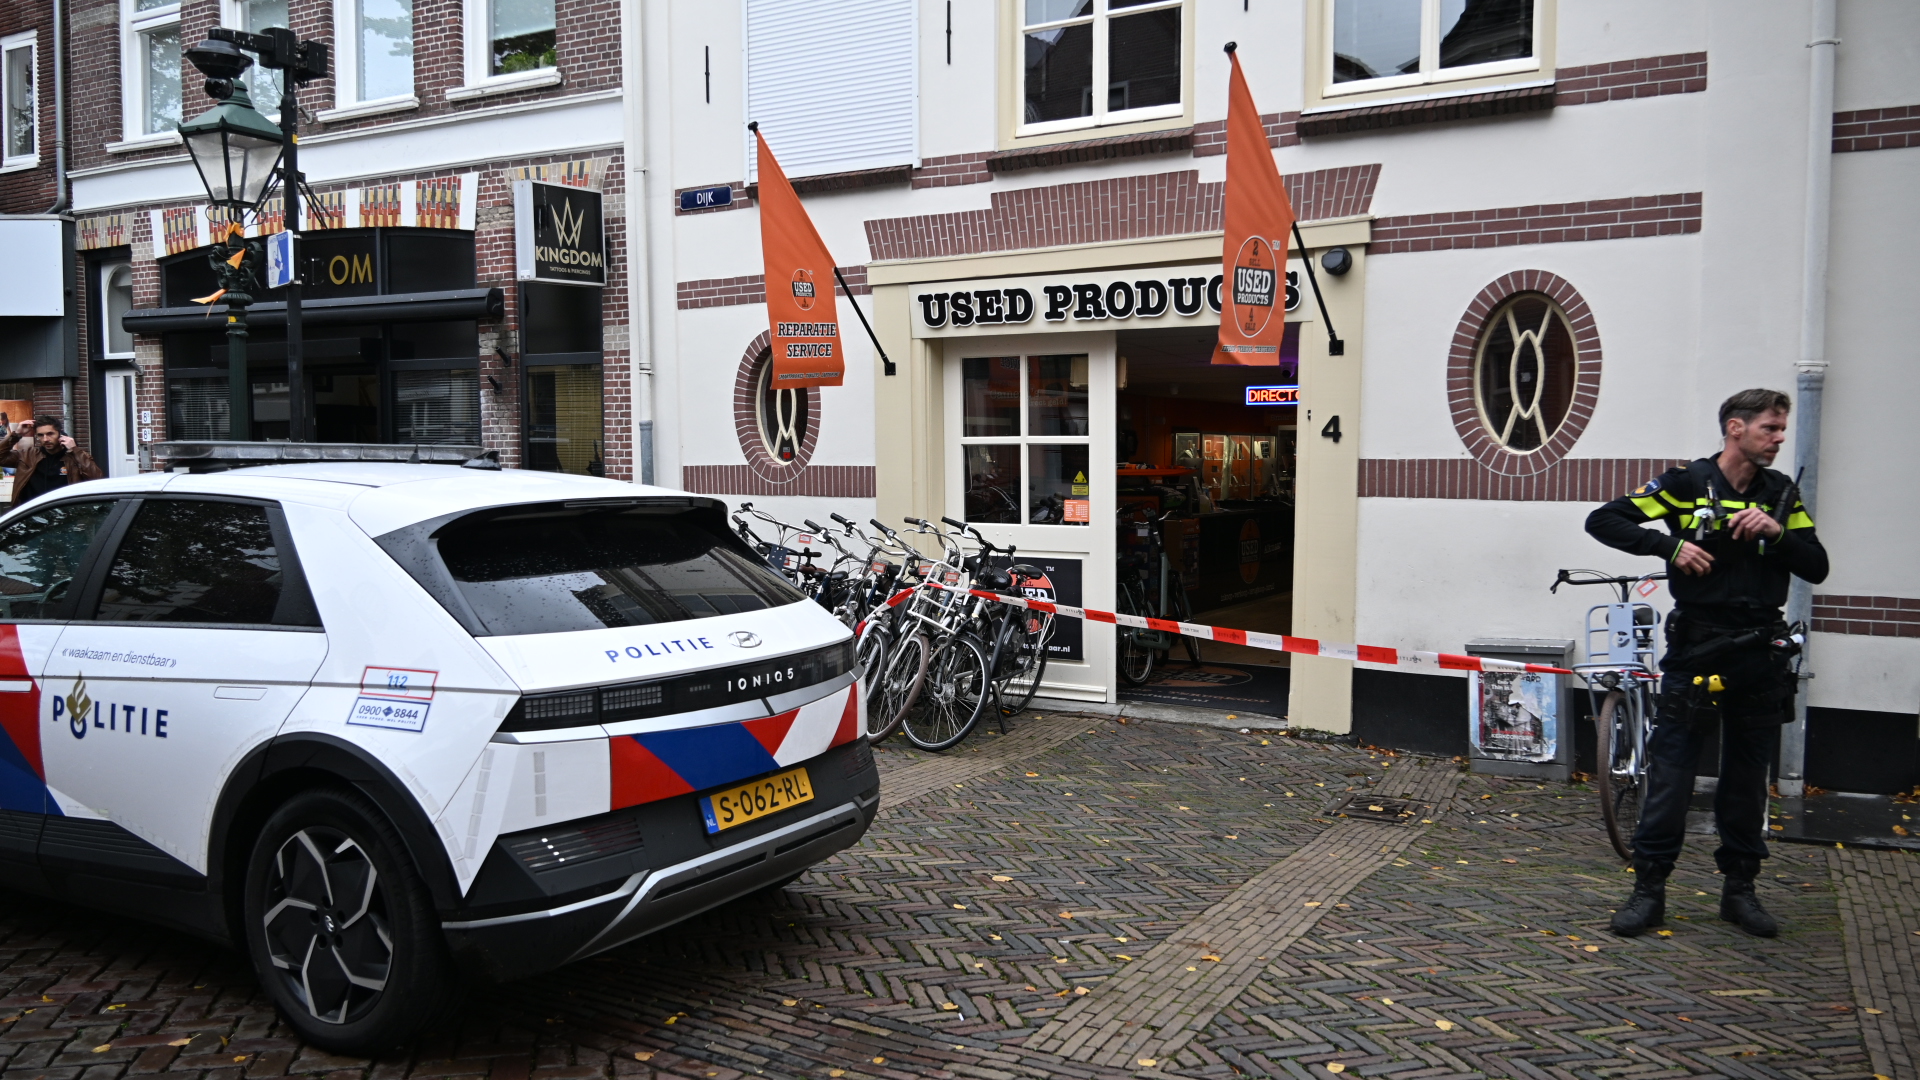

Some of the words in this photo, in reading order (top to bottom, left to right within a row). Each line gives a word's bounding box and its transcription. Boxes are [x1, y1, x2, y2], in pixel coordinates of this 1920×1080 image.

[696, 191, 714, 206] DIJK
[535, 245, 603, 267] KINGDOM
[1252, 240, 1259, 256] 2
[794, 282, 812, 293] USED
[1237, 268, 1272, 293] USED
[918, 287, 1035, 328] USED
[1237, 293, 1269, 305] PRODUCTS
[777, 322, 837, 337] REPARATIE
[786, 343, 832, 358] SERVICE
[1321, 415, 1342, 443] 4
[68, 647, 111, 661] waakzaam
[112, 652, 123, 662] en
[123, 651, 170, 667] dienstbaar
[604, 637, 714, 663] POLITIE
[53, 695, 169, 739] POLITIE
[358, 705, 381, 716] 0900
[393, 708, 419, 720] 8844
[720, 774, 808, 823] S-062-RL
[706, 818, 716, 827] NL
